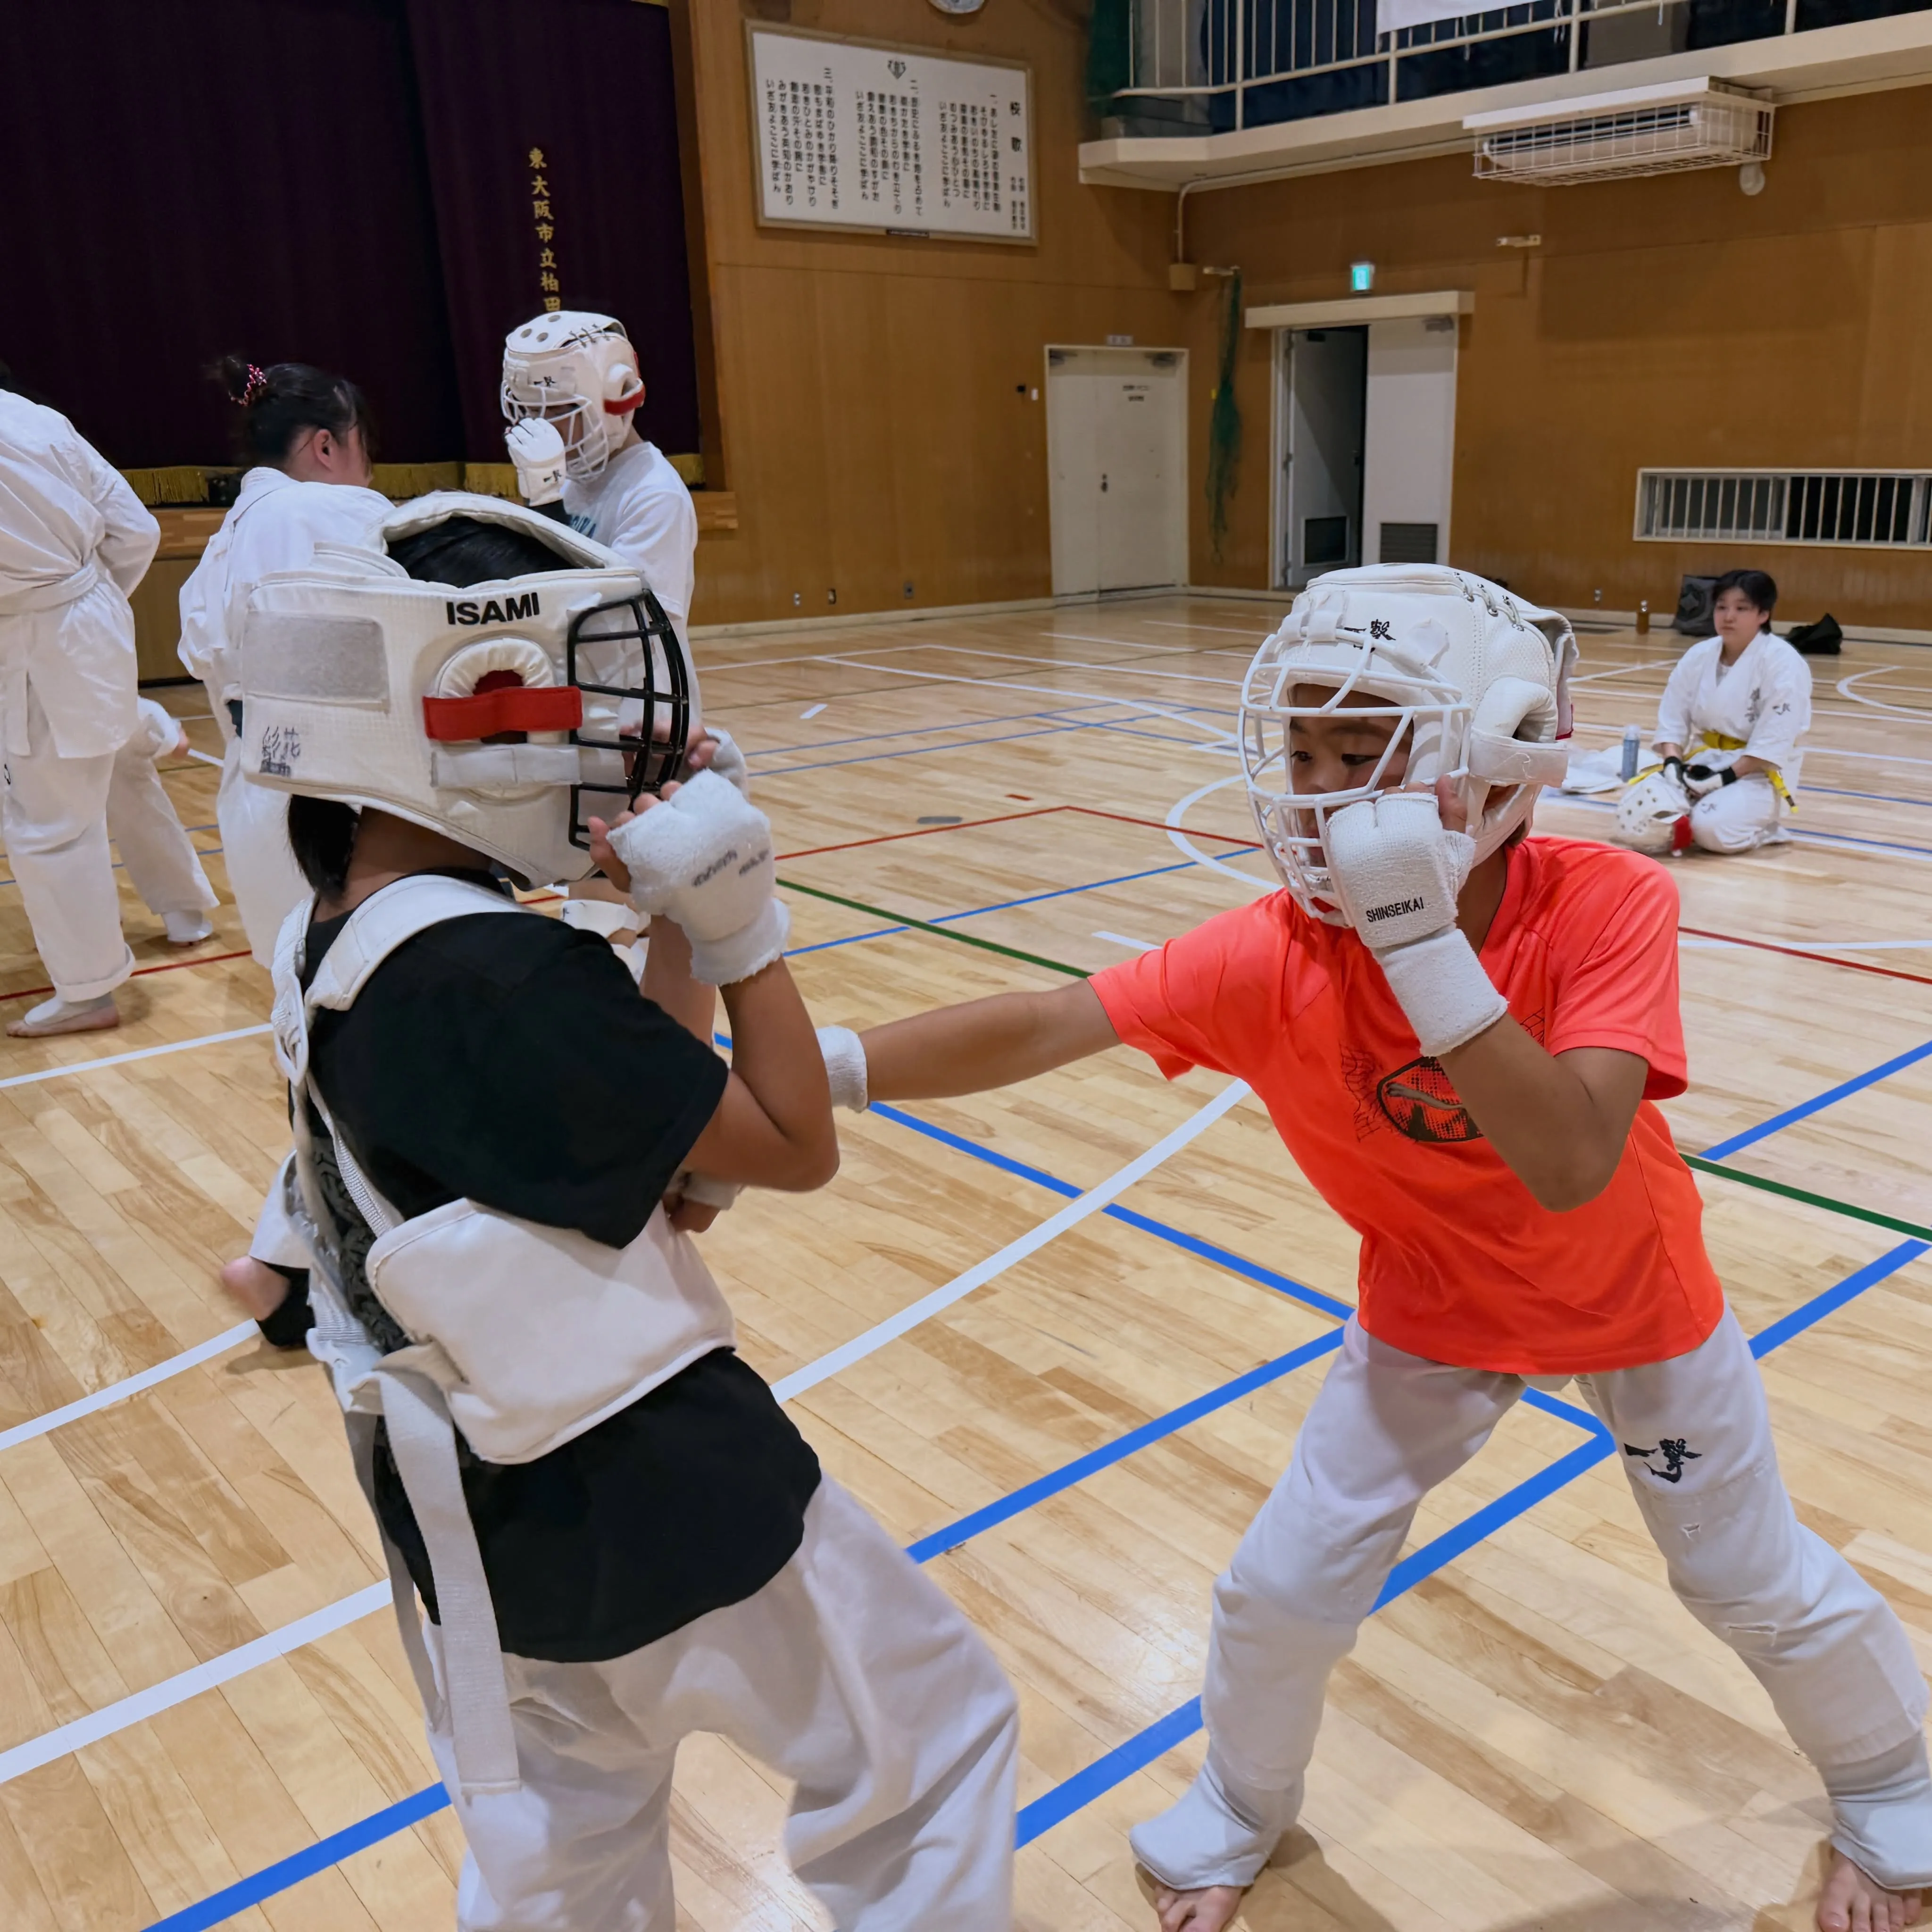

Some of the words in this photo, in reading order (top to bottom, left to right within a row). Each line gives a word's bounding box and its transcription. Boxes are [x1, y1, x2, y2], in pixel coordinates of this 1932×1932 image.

[528, 147, 561, 311] 東大阪市立柏田
[446, 592, 540, 625] ISAMI
[1366, 897, 1424, 922] SHINSEIKAI
